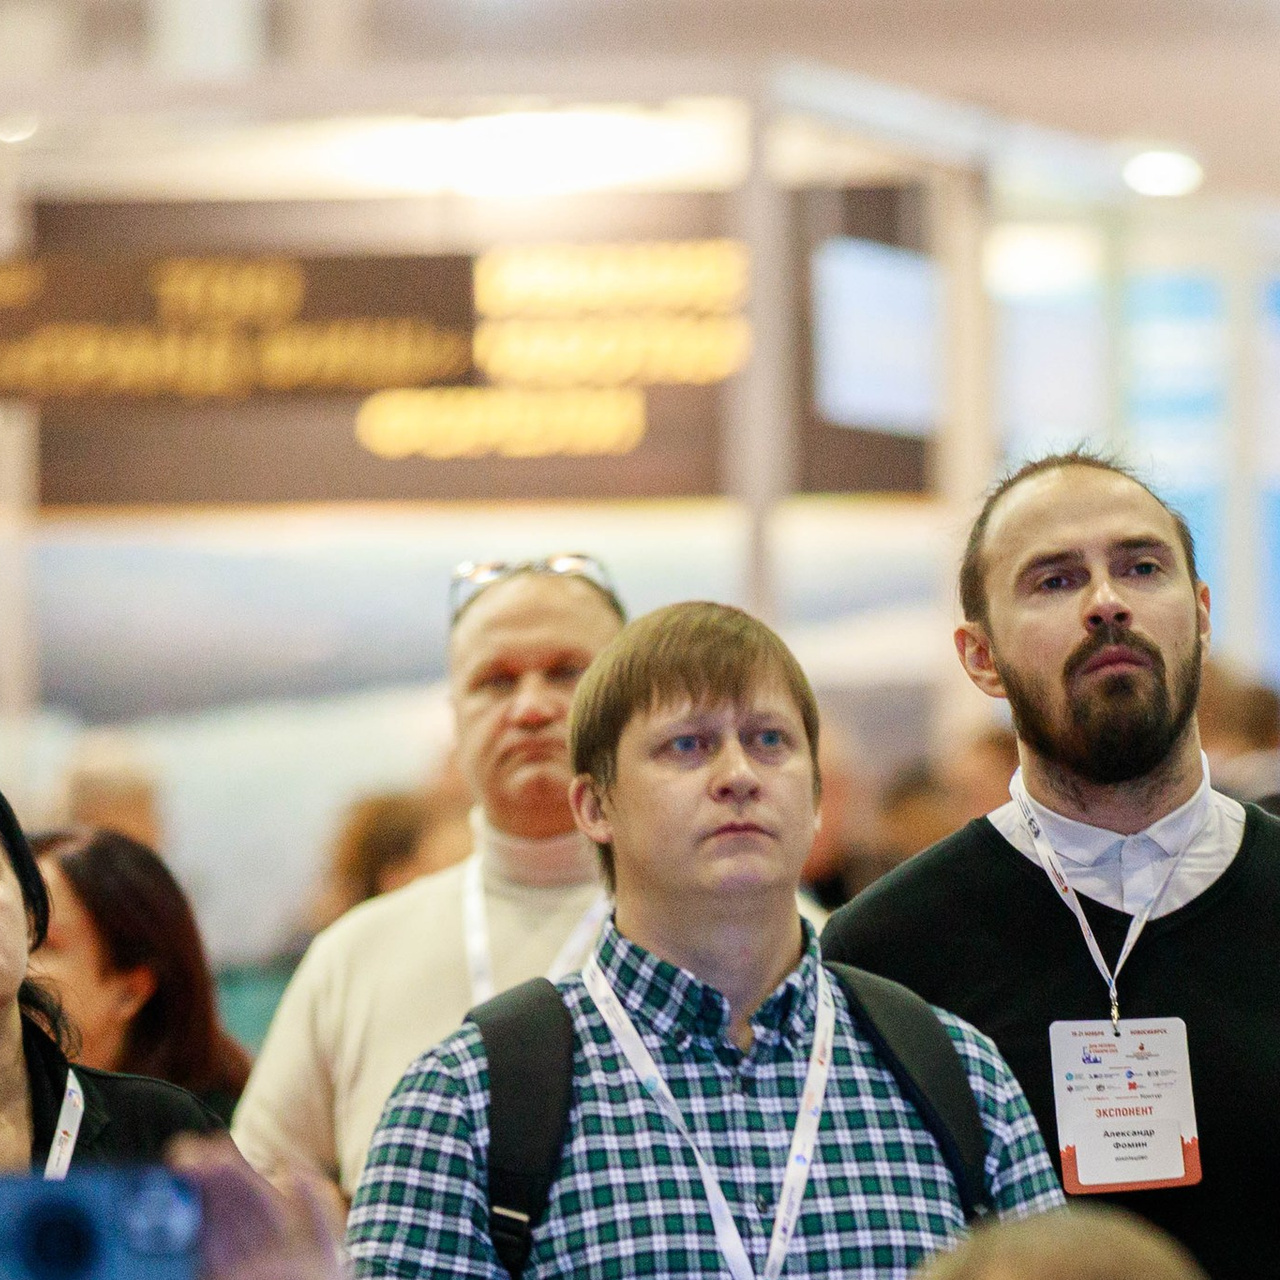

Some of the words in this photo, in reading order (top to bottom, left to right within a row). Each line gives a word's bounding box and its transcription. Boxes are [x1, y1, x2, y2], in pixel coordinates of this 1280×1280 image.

[1095, 1106, 1154, 1118] ЭКСПОНЕНТ
[1103, 1129, 1155, 1138] Александр
[1112, 1141, 1148, 1149] Фомин
